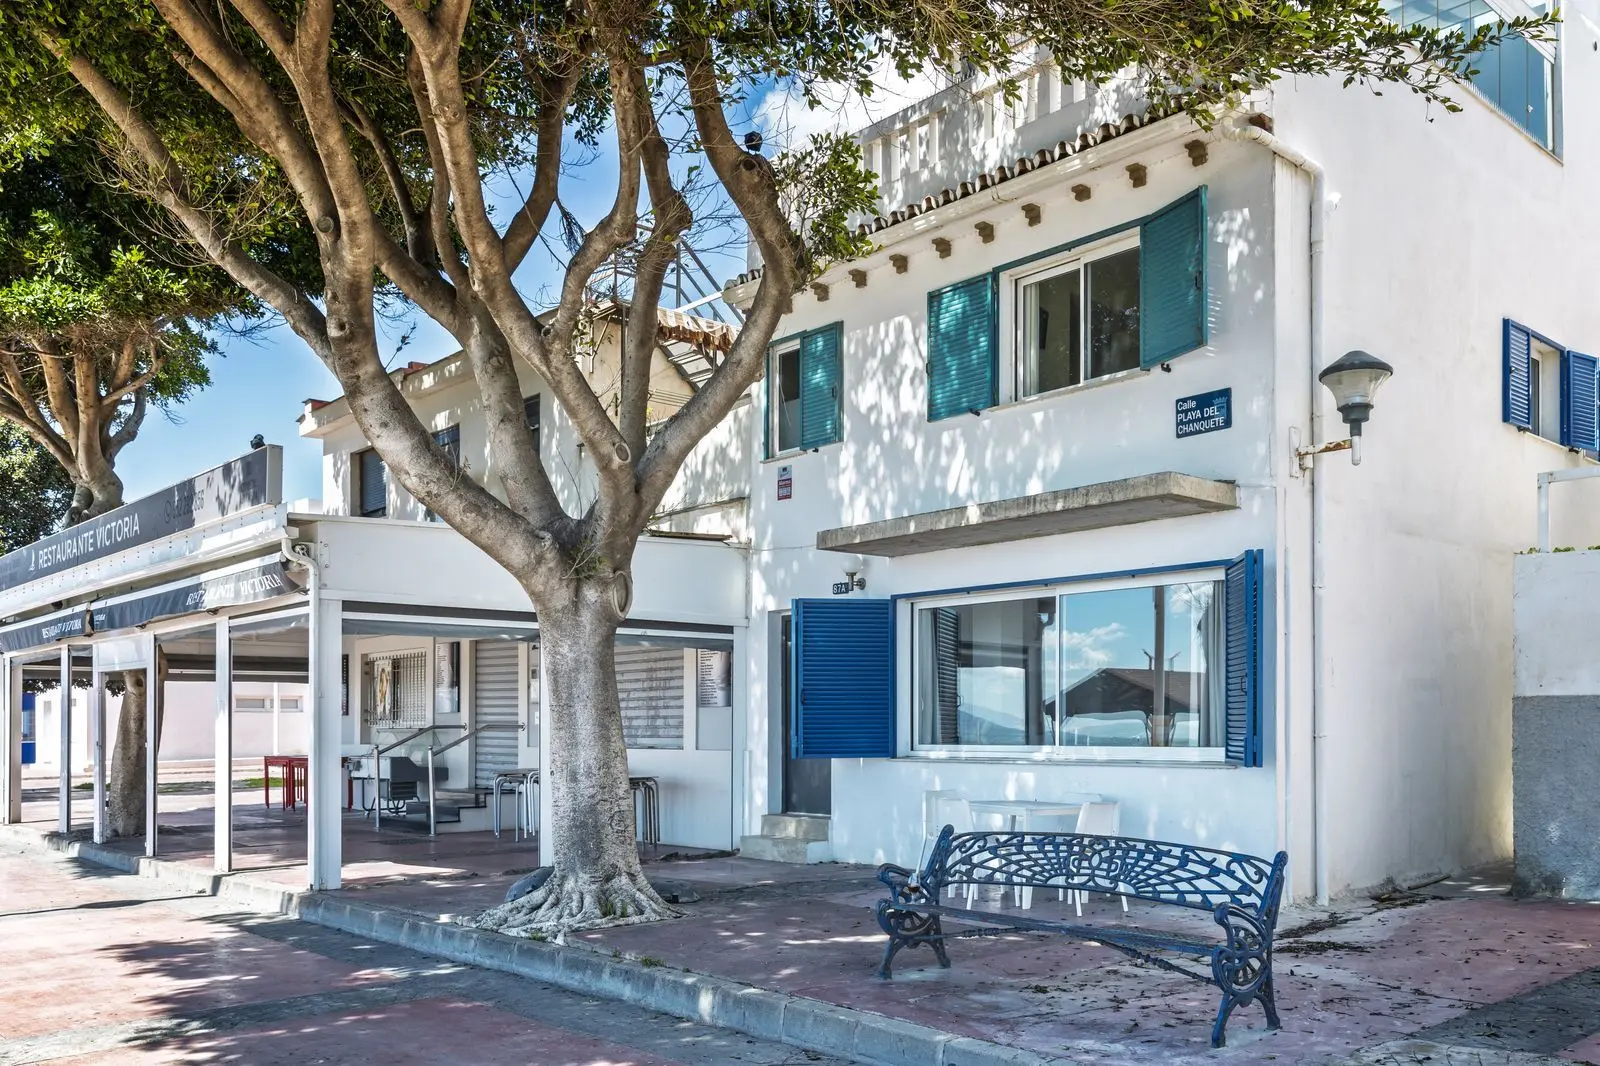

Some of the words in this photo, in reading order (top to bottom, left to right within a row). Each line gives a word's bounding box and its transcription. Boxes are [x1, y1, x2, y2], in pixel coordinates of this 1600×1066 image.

[1178, 400, 1196, 410] Calle
[1178, 410, 1201, 422] PLAYA
[1204, 406, 1219, 417] DEL
[1178, 417, 1224, 434] CHANQUETE
[38, 530, 94, 570] RESTAURANTE
[96, 513, 140, 549] VICTORIA
[239, 573, 283, 595] VICTORIA
